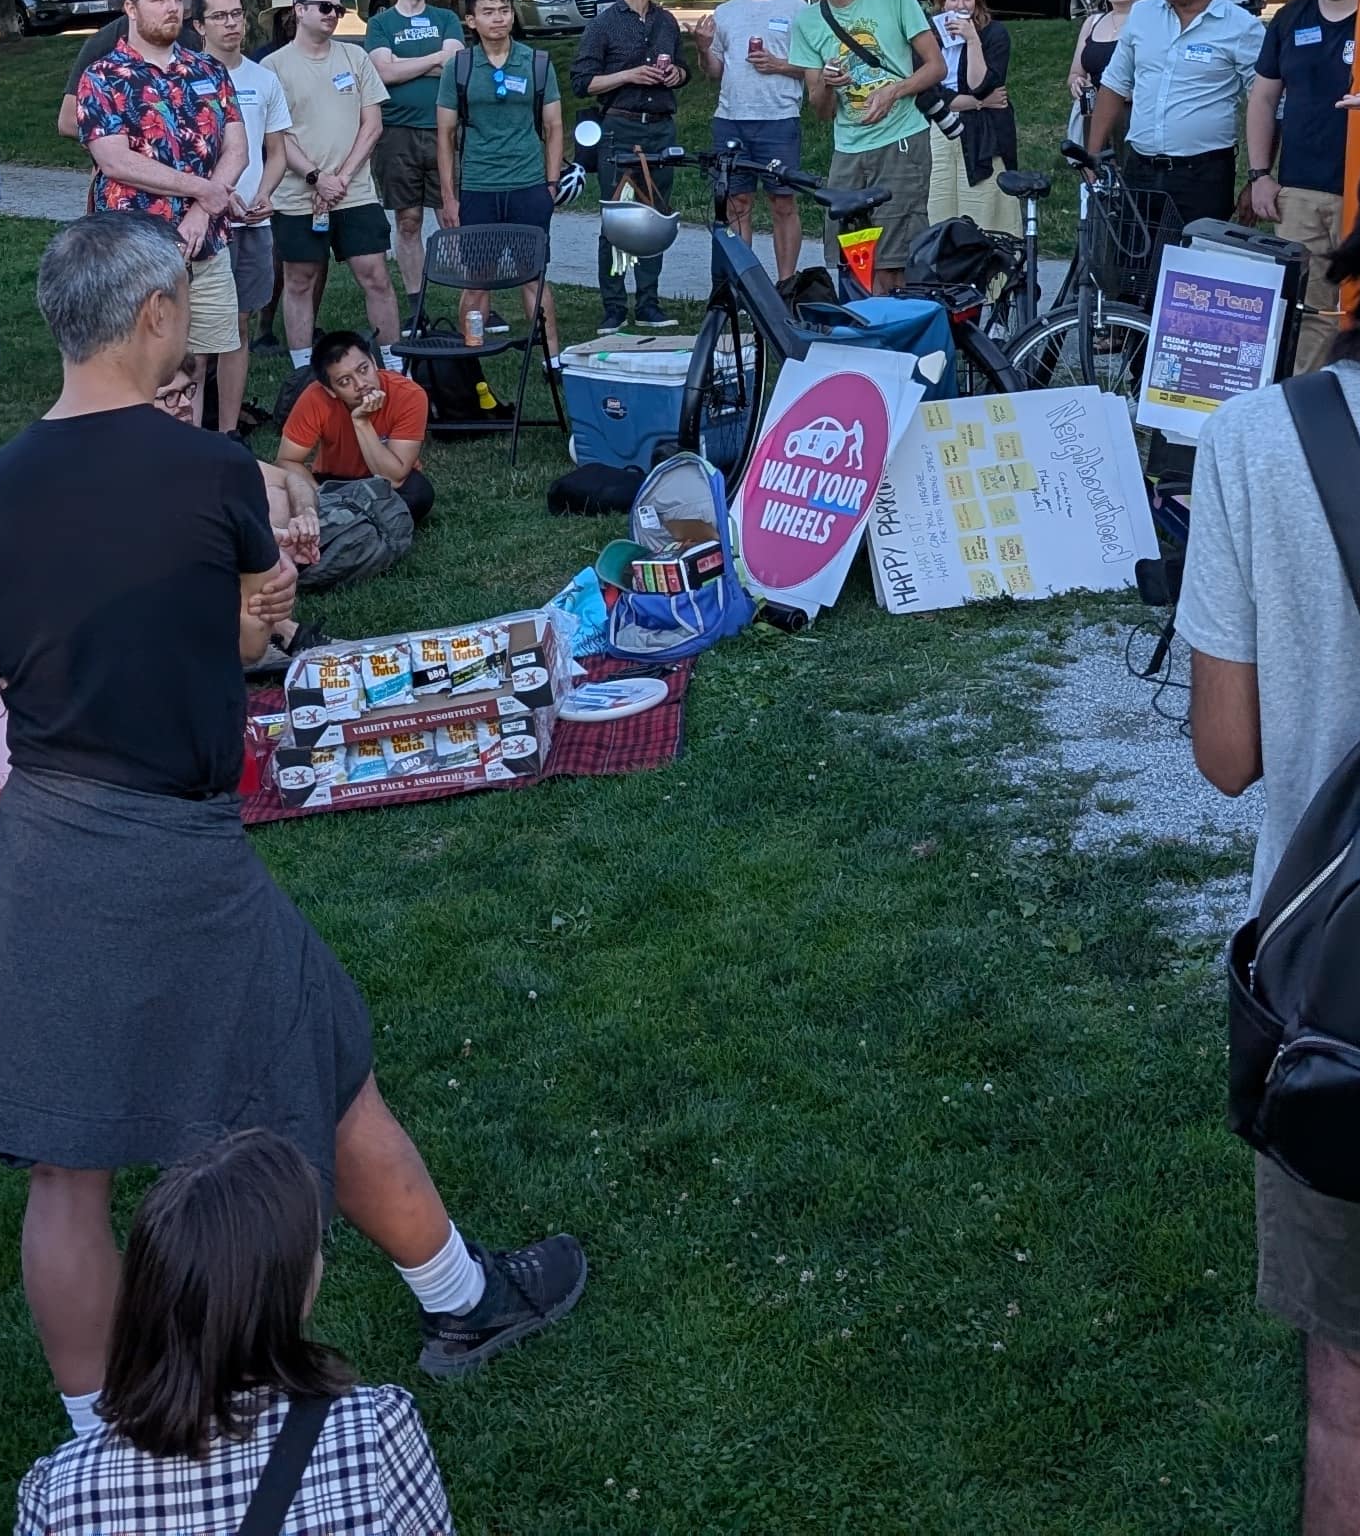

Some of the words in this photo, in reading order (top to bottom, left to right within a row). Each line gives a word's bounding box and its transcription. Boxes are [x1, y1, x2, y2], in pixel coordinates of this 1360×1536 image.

[1173, 281, 1211, 309] Big
[1214, 288, 1264, 313] Tent
[1192, 341, 1222, 352] AUGUST
[758, 459, 817, 498] WALK
[813, 470, 868, 510] YOUR
[1046, 399, 1134, 564] Neighbourhood
[760, 499, 837, 545] WHEELS
[882, 547, 921, 607] HAPPY
[369, 654, 388, 666] Old
[453, 647, 484, 661] Dutch
[319, 667, 338, 678] Old
[371, 665, 400, 678] Dutch
[426, 668, 446, 681] BBQ
[320, 678, 350, 689] Dutch
[352, 721, 392, 735] VARIETY
[392, 717, 417, 727] PACK
[425, 705, 488, 723] ASSORTMENT
[393, 741, 425, 754] Dutch
[311, 753, 335, 764] utch
[401, 757, 420, 770] BBQ
[340, 785, 379, 797] VARIETY
[380, 781, 405, 791] PACK
[413, 771, 476, 787] ASSORTMENT
